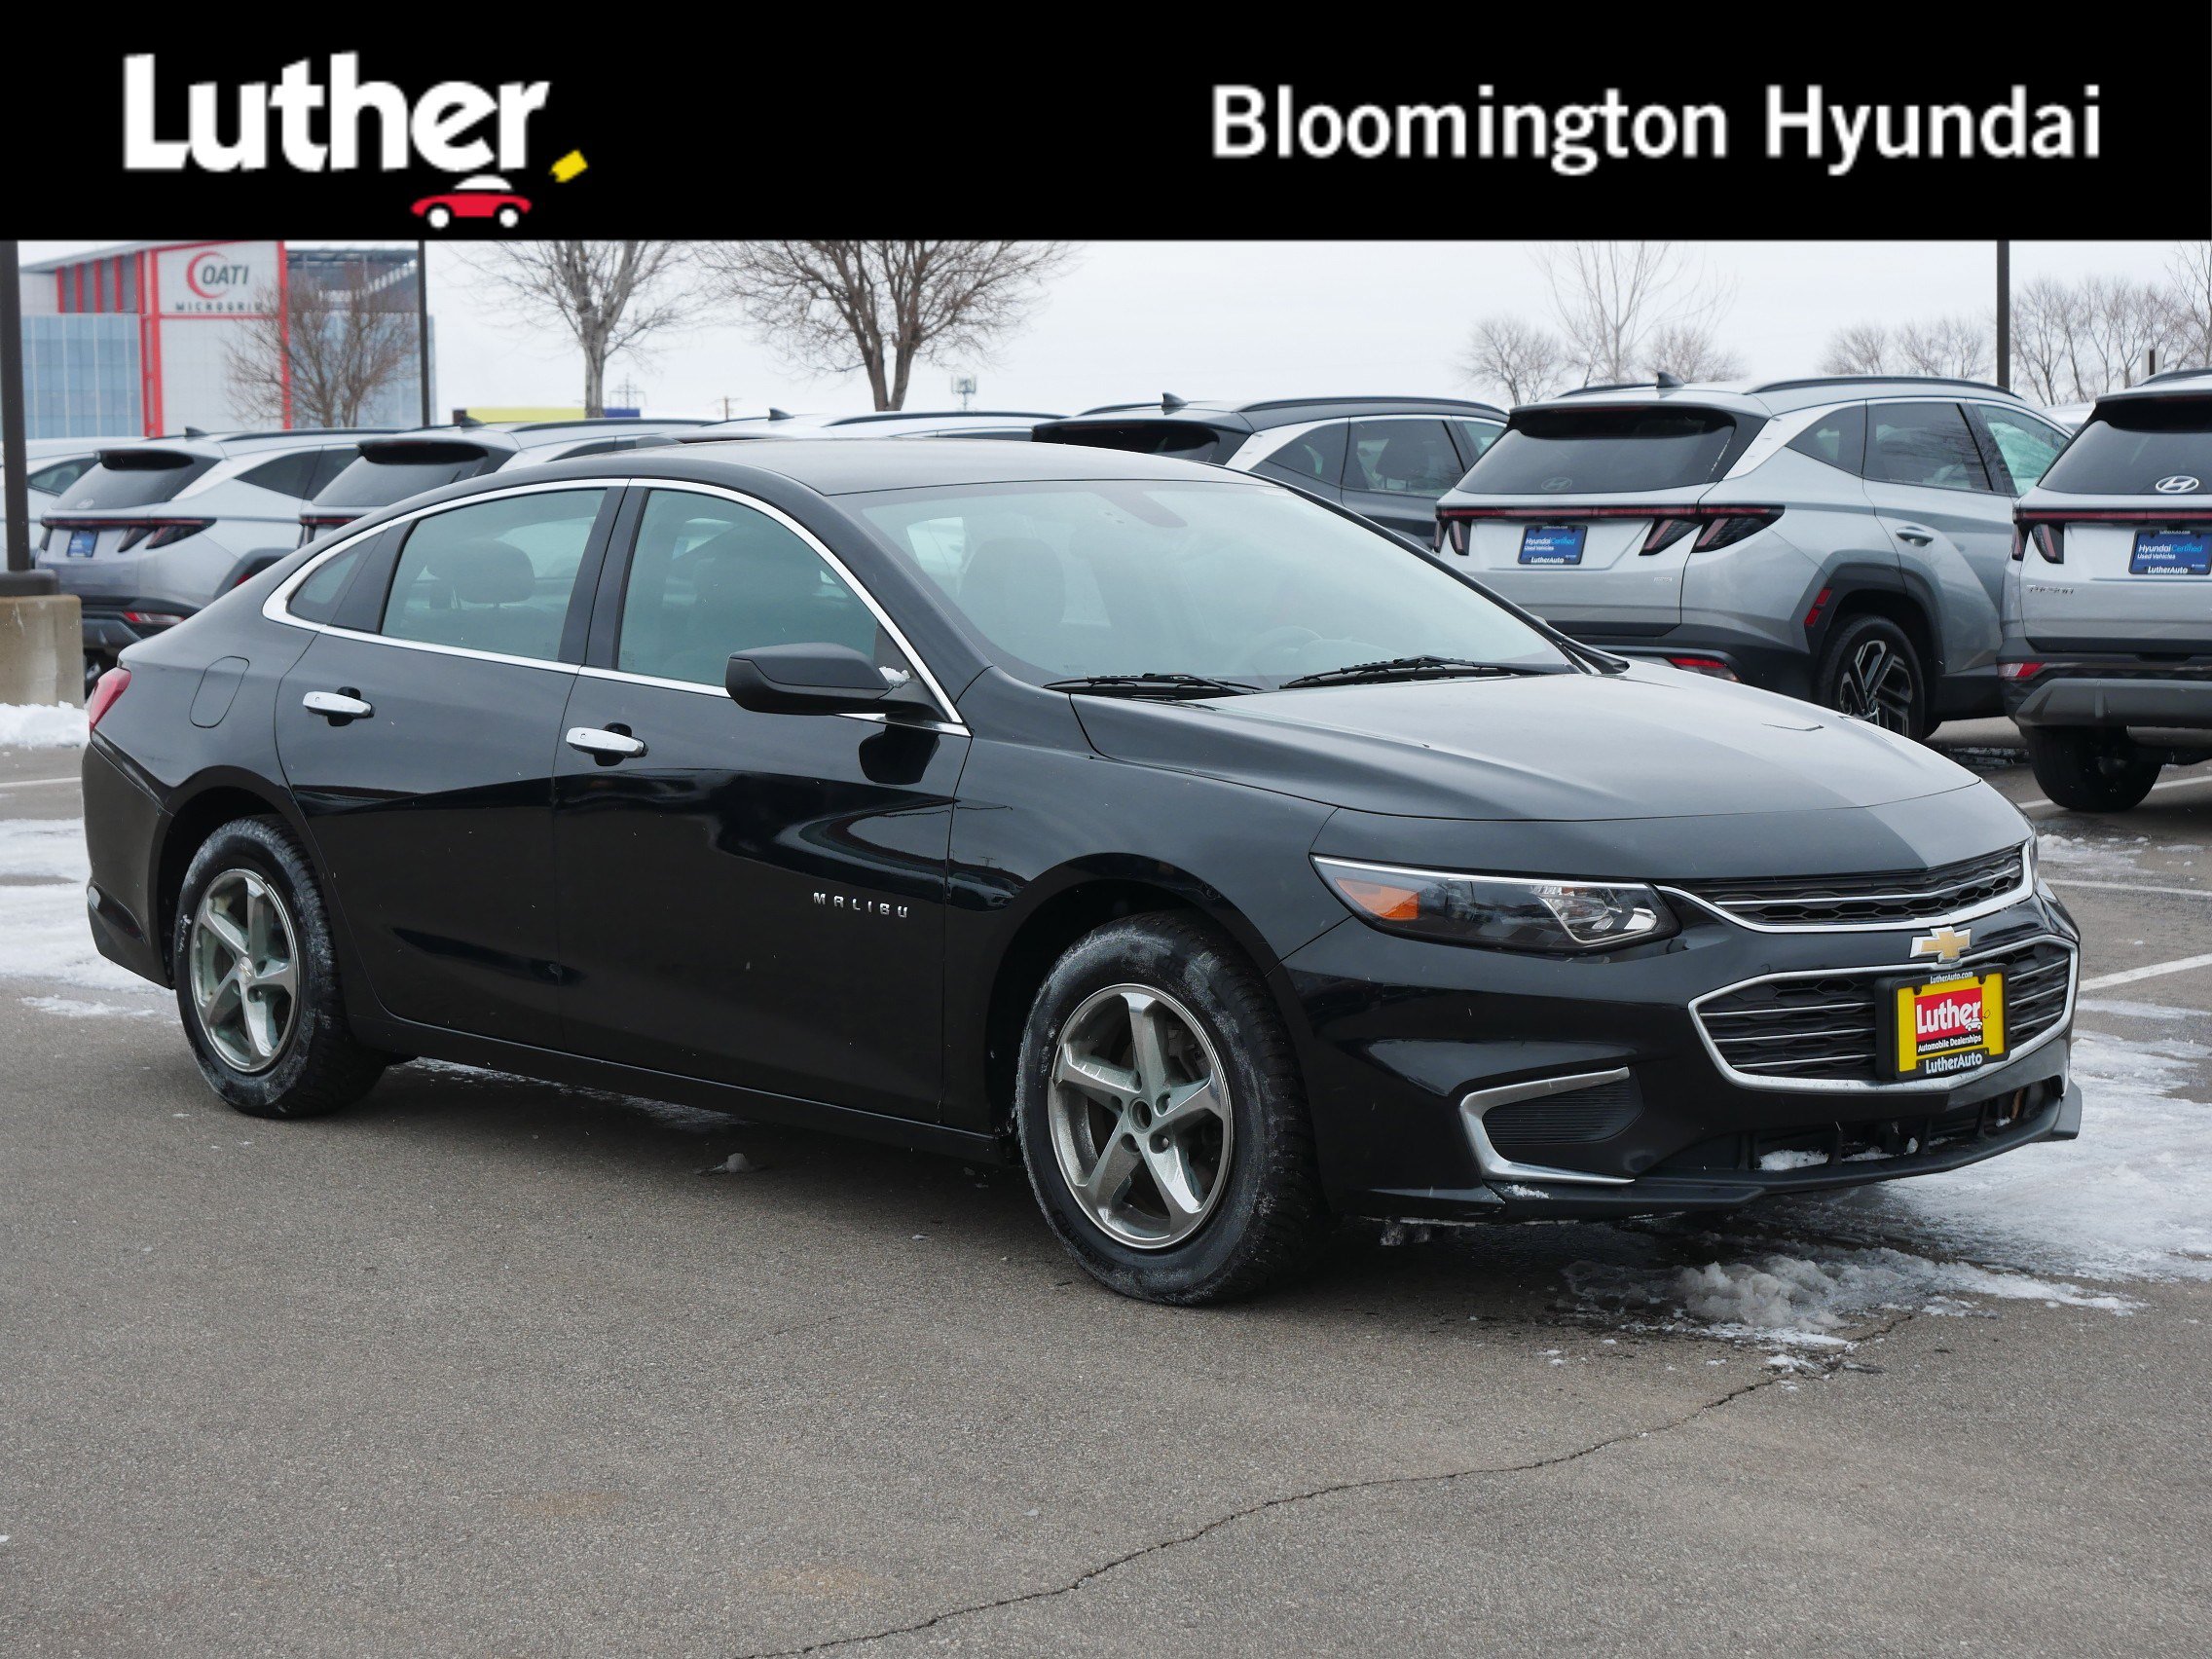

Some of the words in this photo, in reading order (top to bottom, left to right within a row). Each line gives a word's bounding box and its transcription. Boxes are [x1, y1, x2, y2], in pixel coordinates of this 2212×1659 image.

[202, 264, 249, 285] OATI
[2138, 543, 2171, 553] Hyundai
[2147, 566, 2189, 574] LutherAuto
[813, 892, 908, 918] MALIBU
[1930, 971, 1973, 984] LutherAuto.com
[1916, 998, 1981, 1034] Luther
[1917, 1040, 1949, 1052] Automobile
[1950, 1034, 1982, 1047] Dealerships
[1925, 1052, 1983, 1074] LutherAuto
